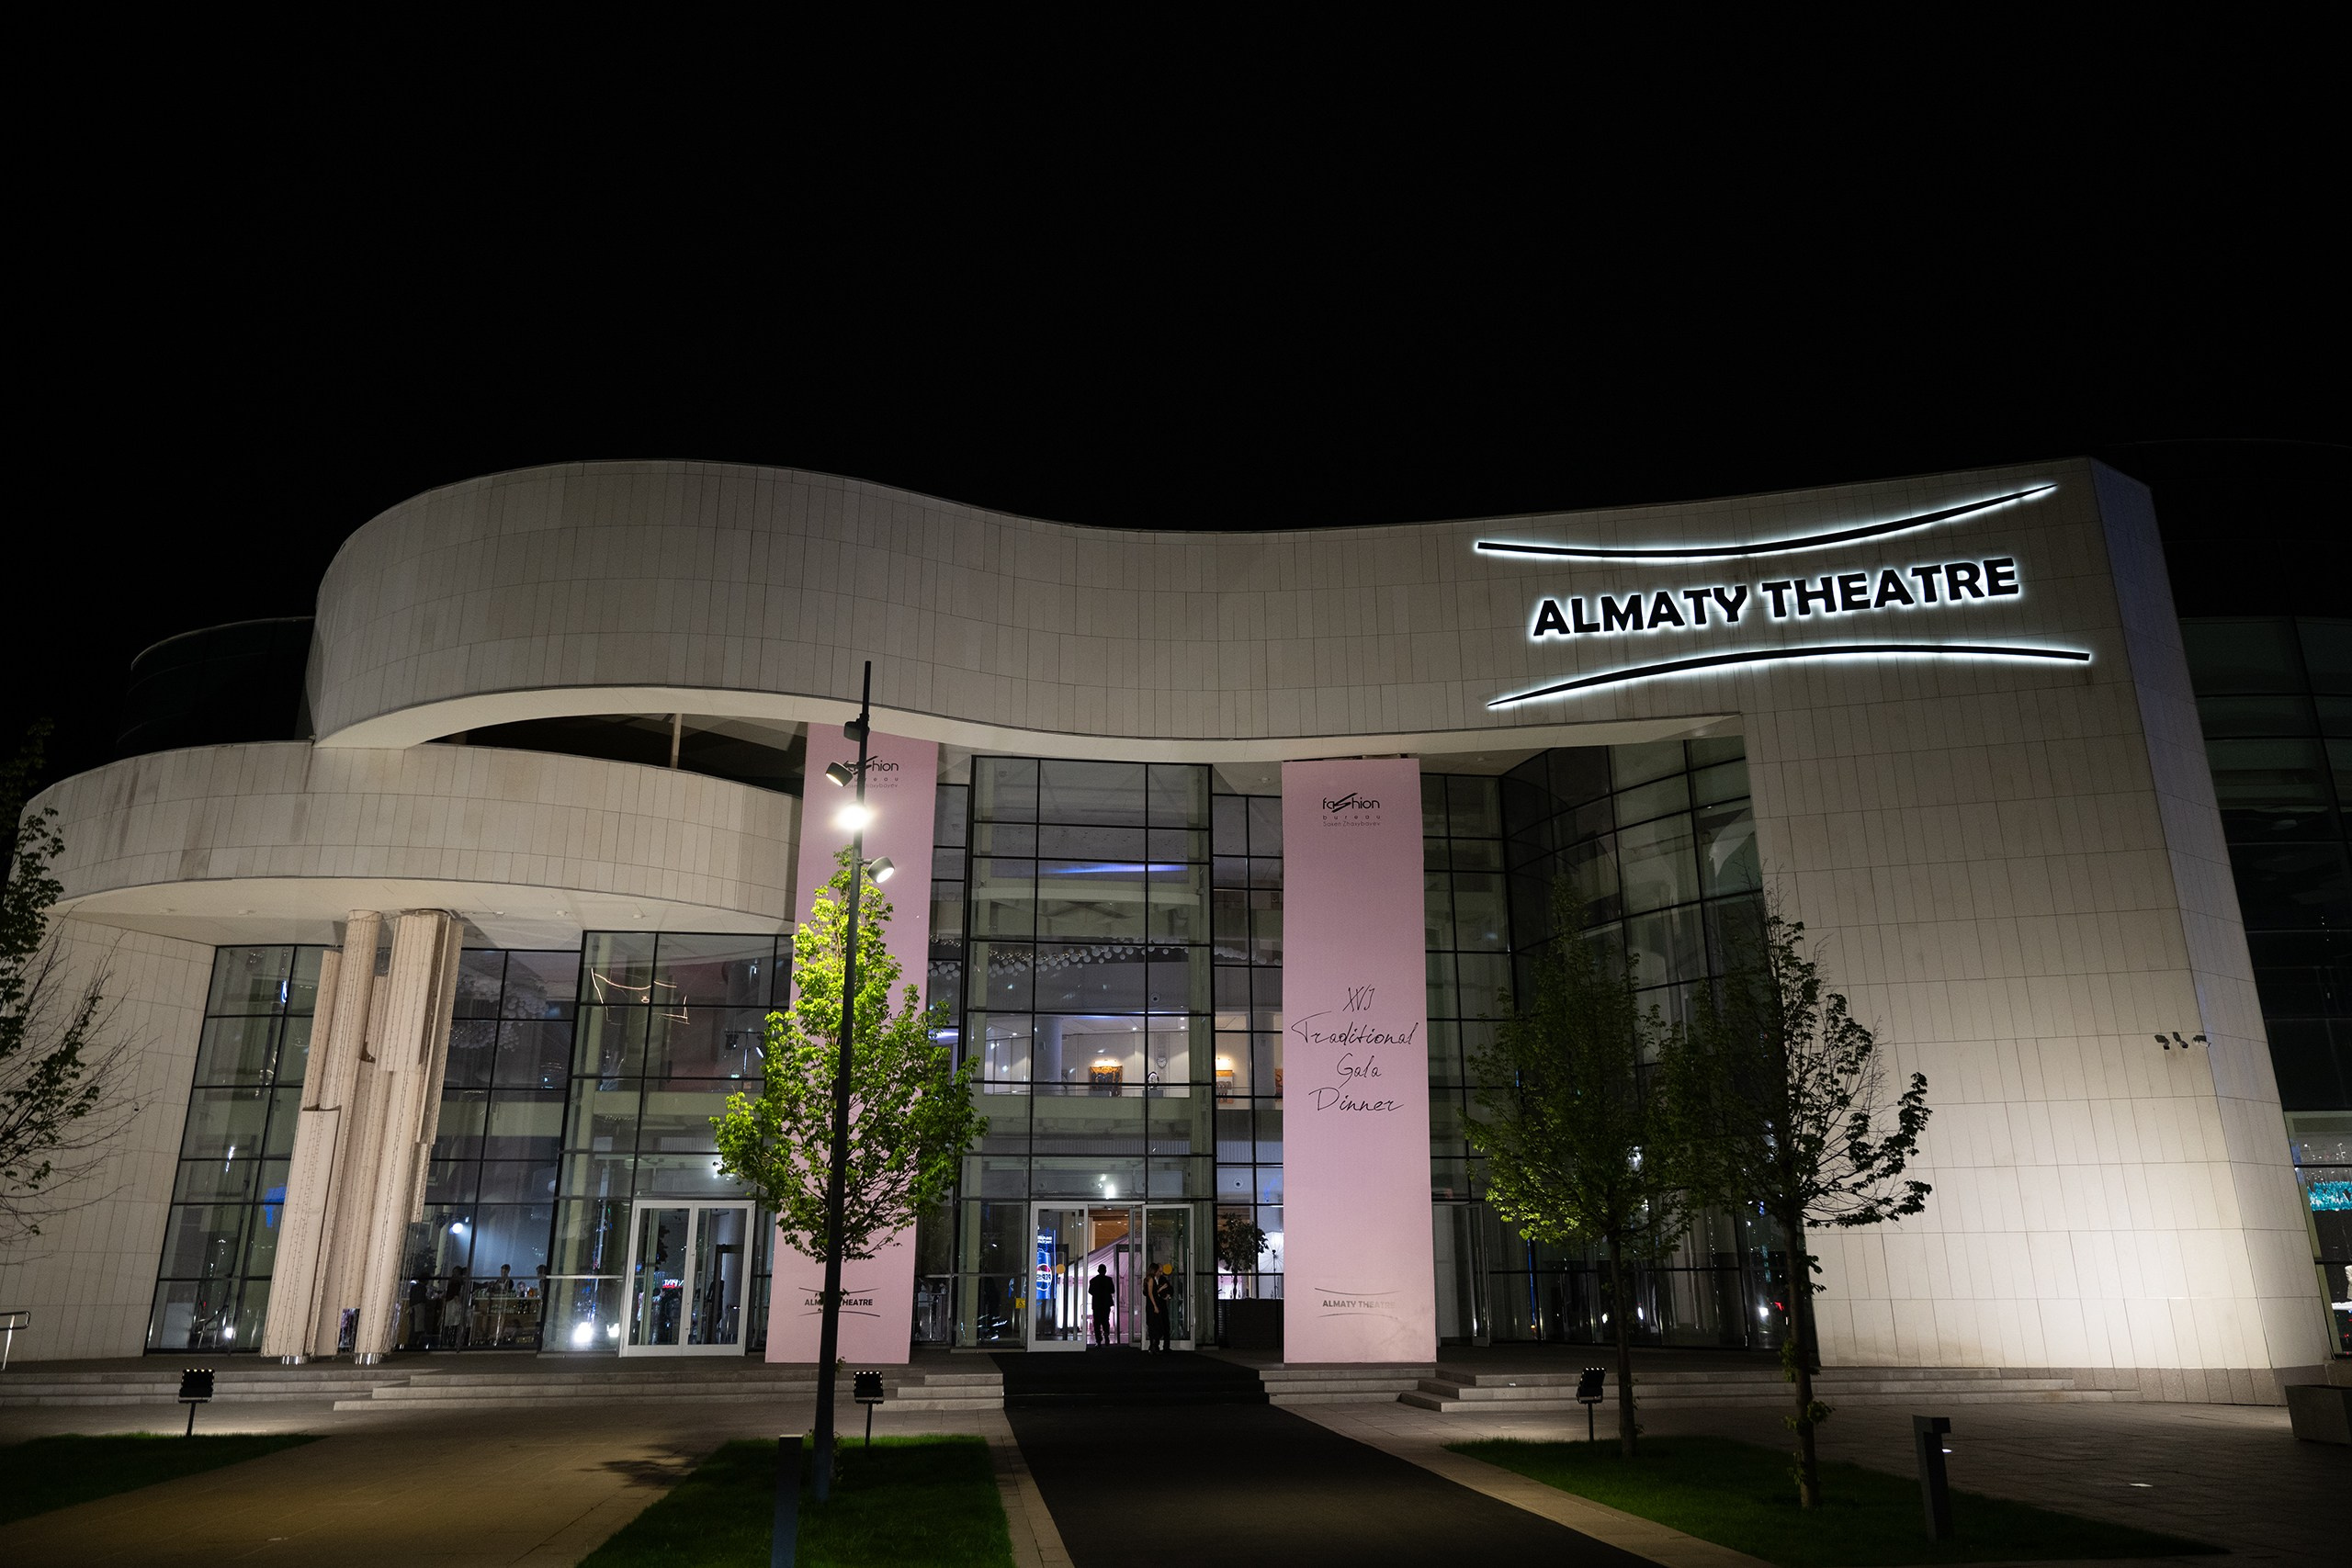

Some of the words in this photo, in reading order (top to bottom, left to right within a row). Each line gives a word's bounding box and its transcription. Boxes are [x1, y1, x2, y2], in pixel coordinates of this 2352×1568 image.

[1532, 584, 1747, 637] ALMATY
[1761, 557, 2019, 618] THEATRE
[1291, 1010, 1419, 1046] Traditional
[1337, 1053, 1382, 1089] Gala
[1308, 1087, 1405, 1111] Dinner
[842, 1298, 874, 1306] HEATRE
[1322, 1300, 1357, 1308] ALMATY
